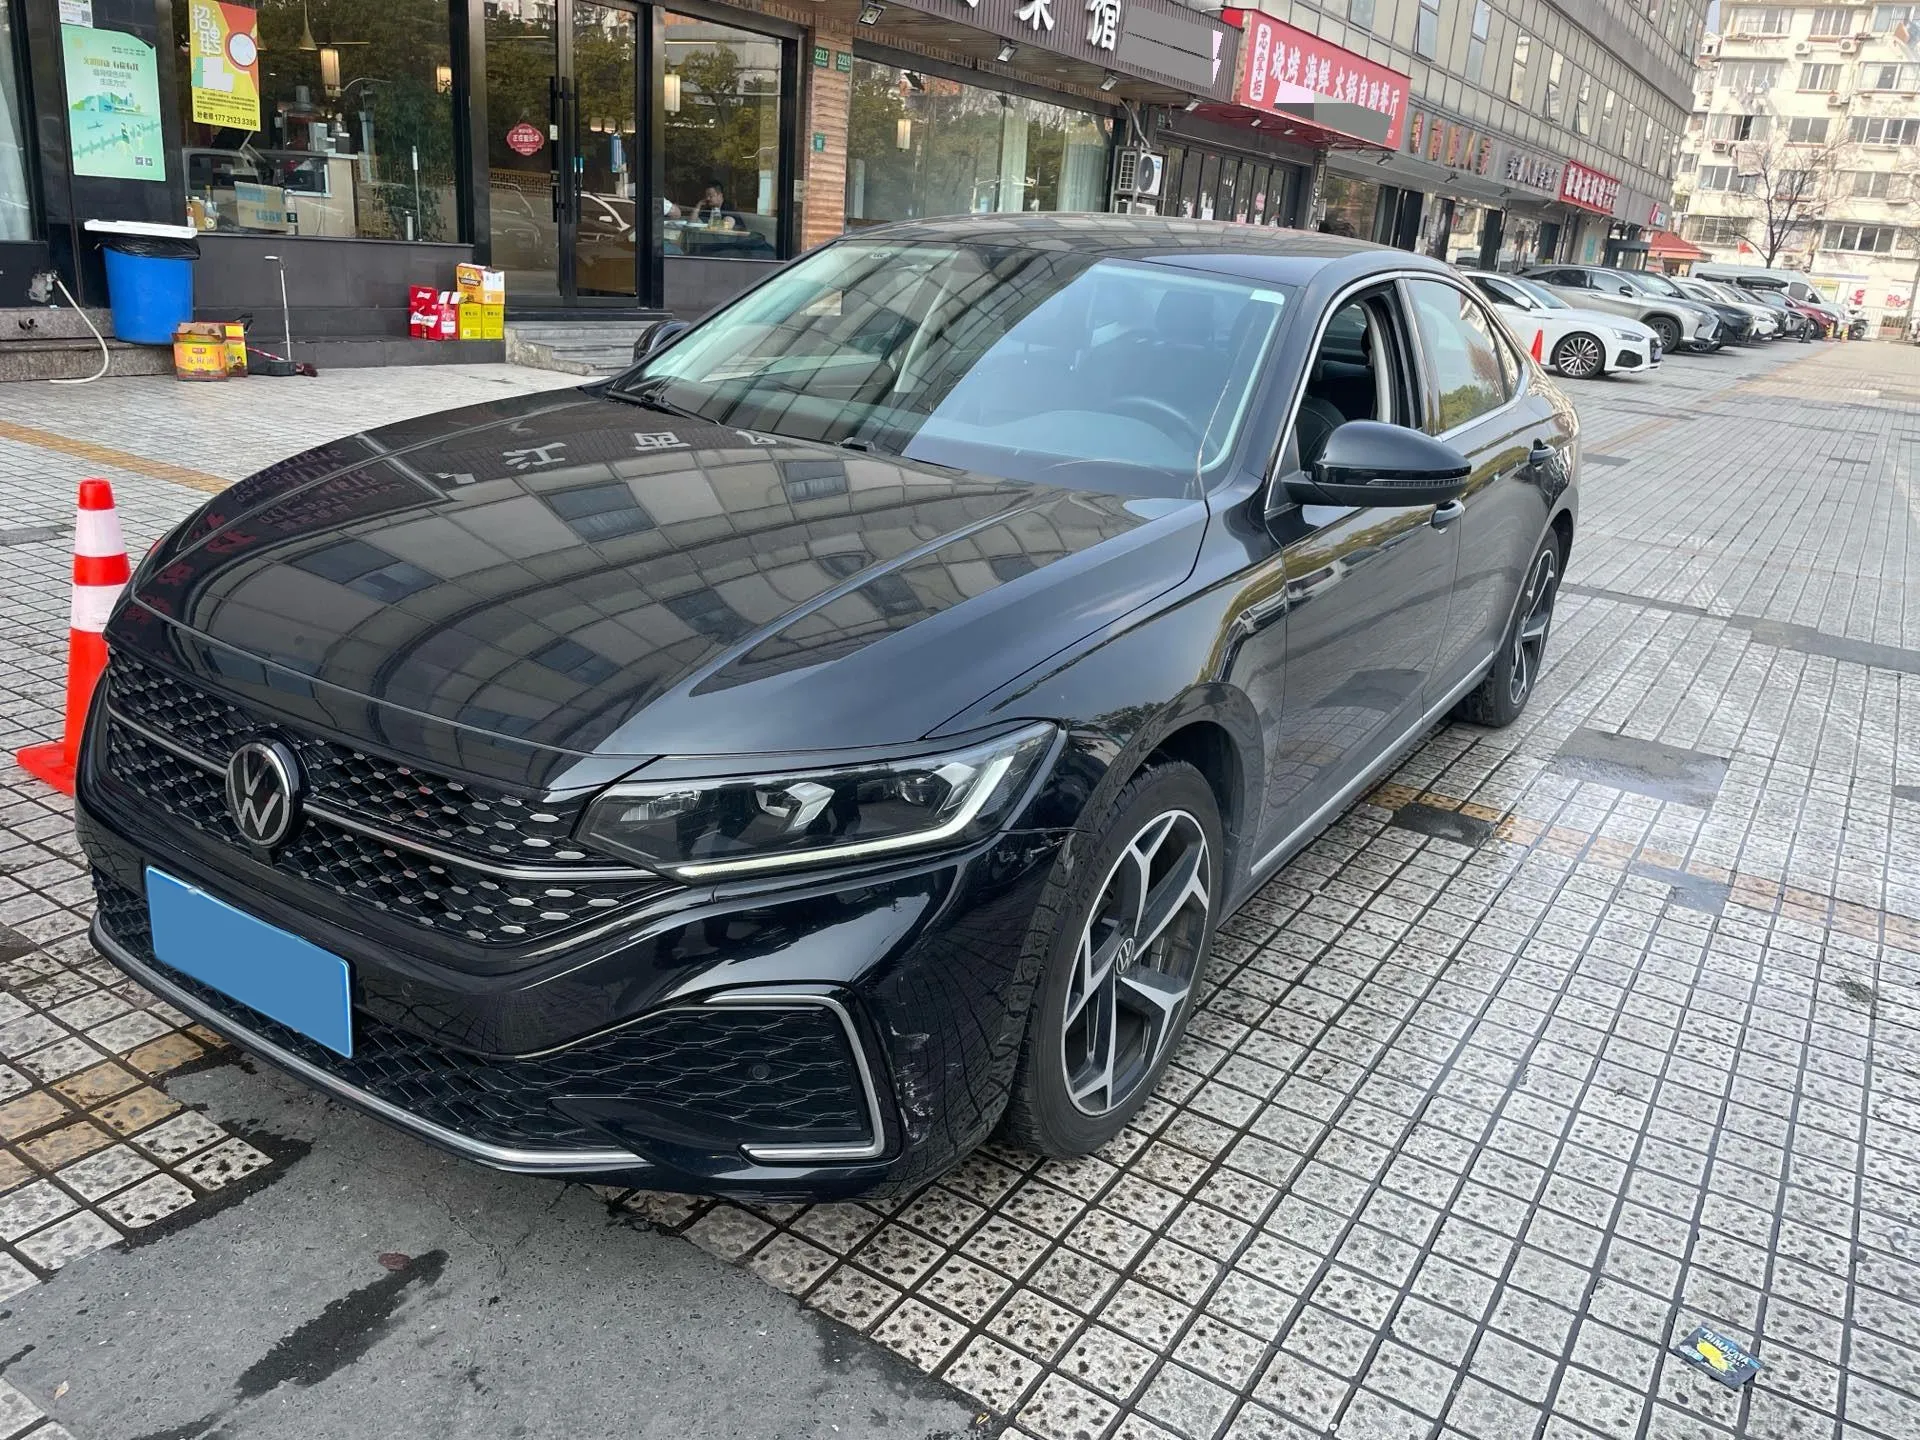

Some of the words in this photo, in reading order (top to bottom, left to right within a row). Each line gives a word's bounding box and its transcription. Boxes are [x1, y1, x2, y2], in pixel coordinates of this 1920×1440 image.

[192, 3, 222, 55] 招聘
[815, 49, 829, 60] 2217
[1270, 41, 1301, 84] 烧烤
[1304, 53, 1331, 94] 海鲜
[1333, 66, 1400, 120] 火锅自助餐厅
